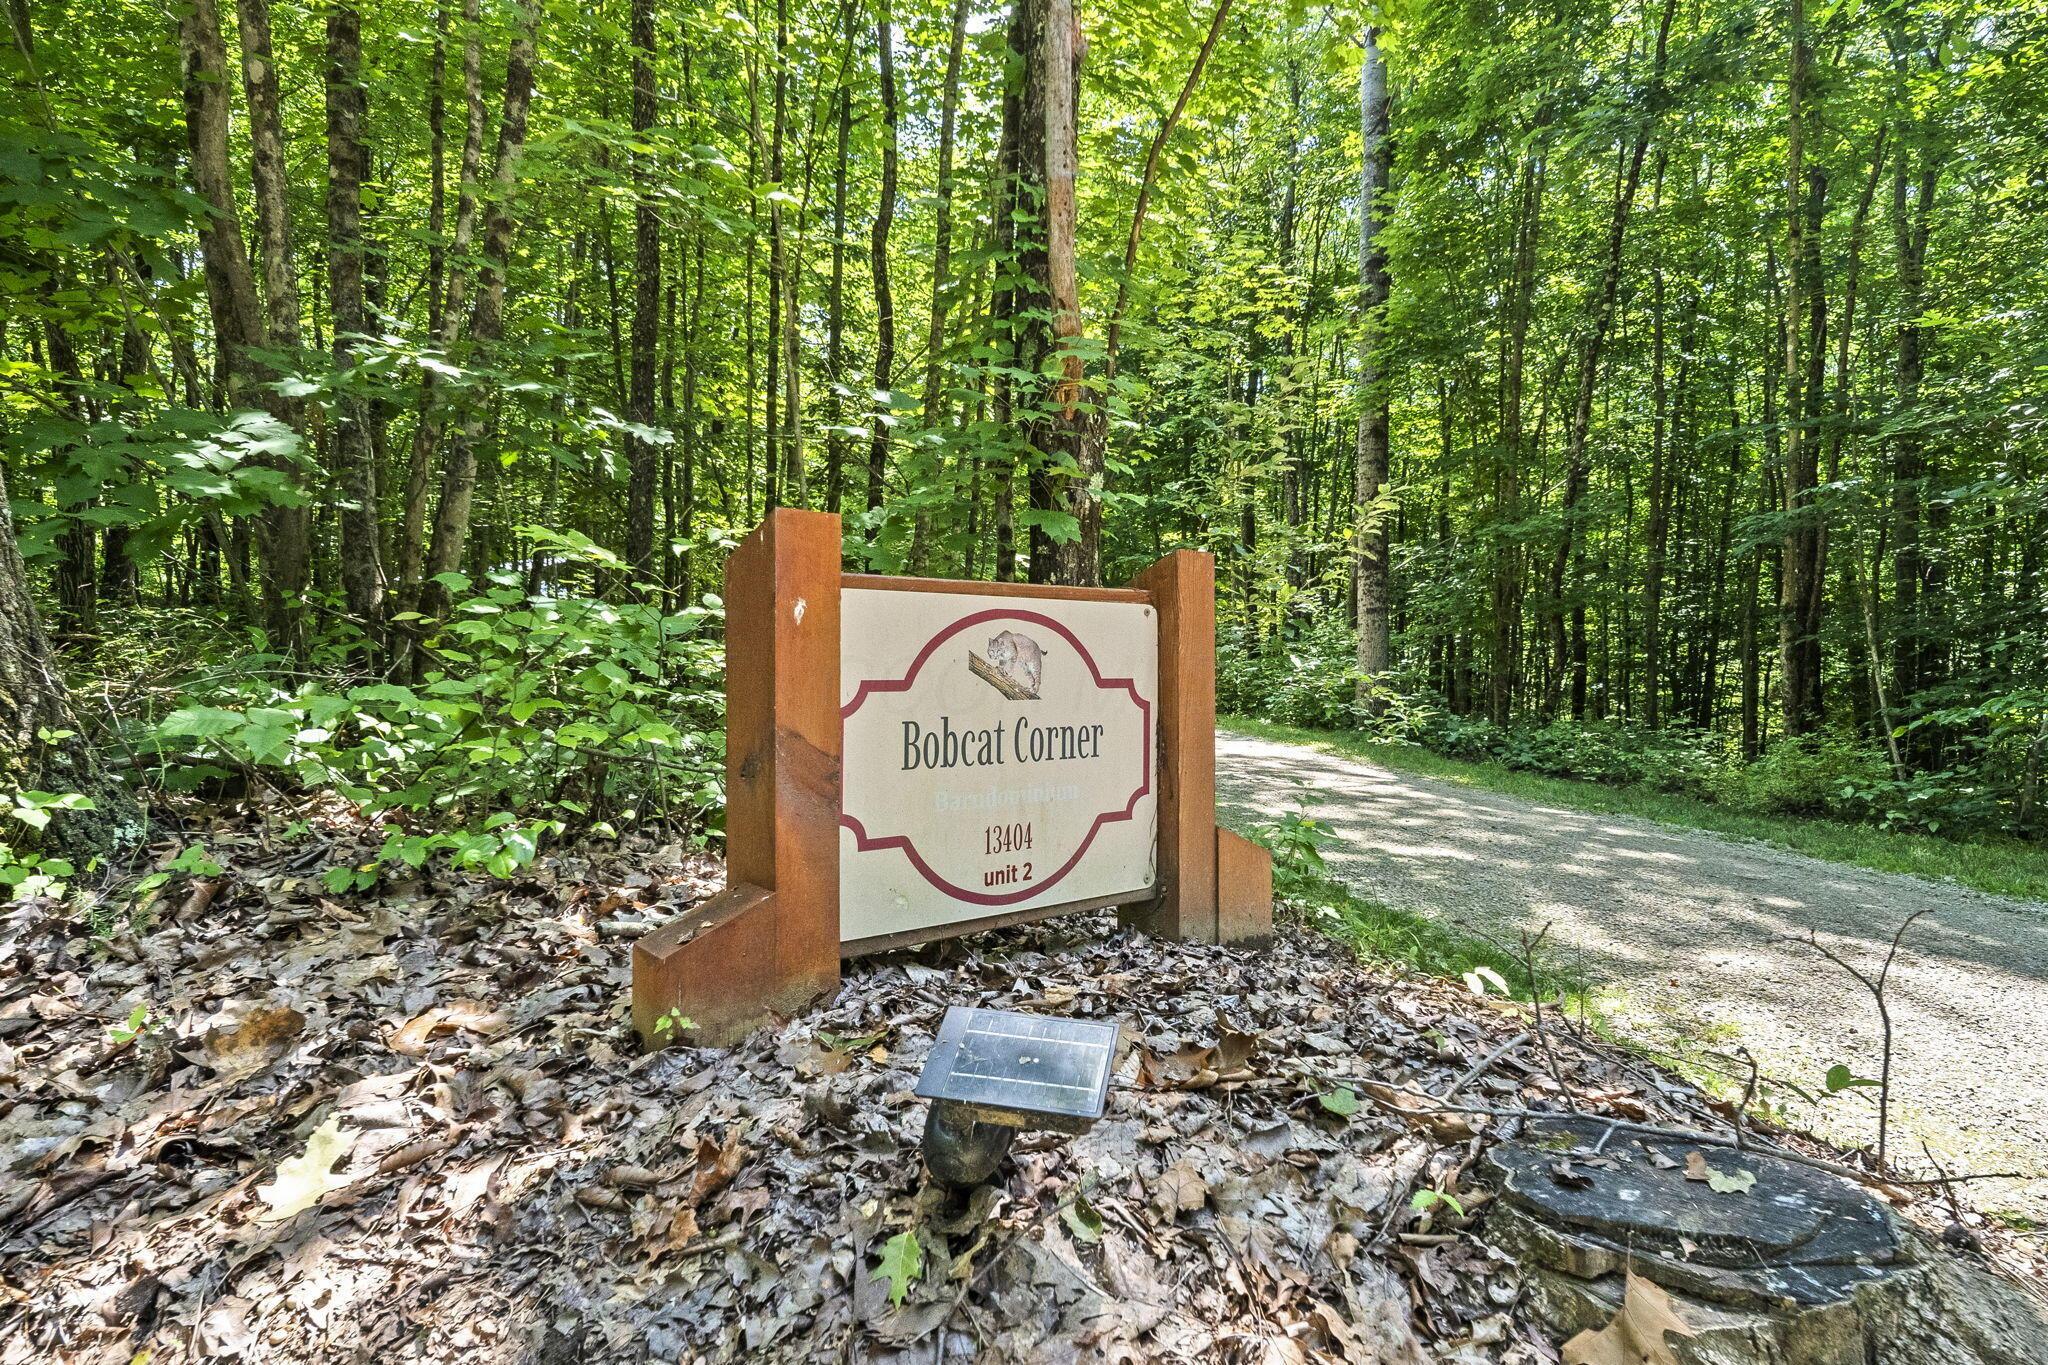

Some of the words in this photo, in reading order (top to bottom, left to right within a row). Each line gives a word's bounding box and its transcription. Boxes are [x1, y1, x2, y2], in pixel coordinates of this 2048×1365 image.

[901, 716, 1005, 771] Bobcat
[1014, 716, 1104, 763] Corner
[985, 822, 1033, 855] 13404
[984, 865, 1018, 887] unit
[1023, 862, 1033, 881] 2
